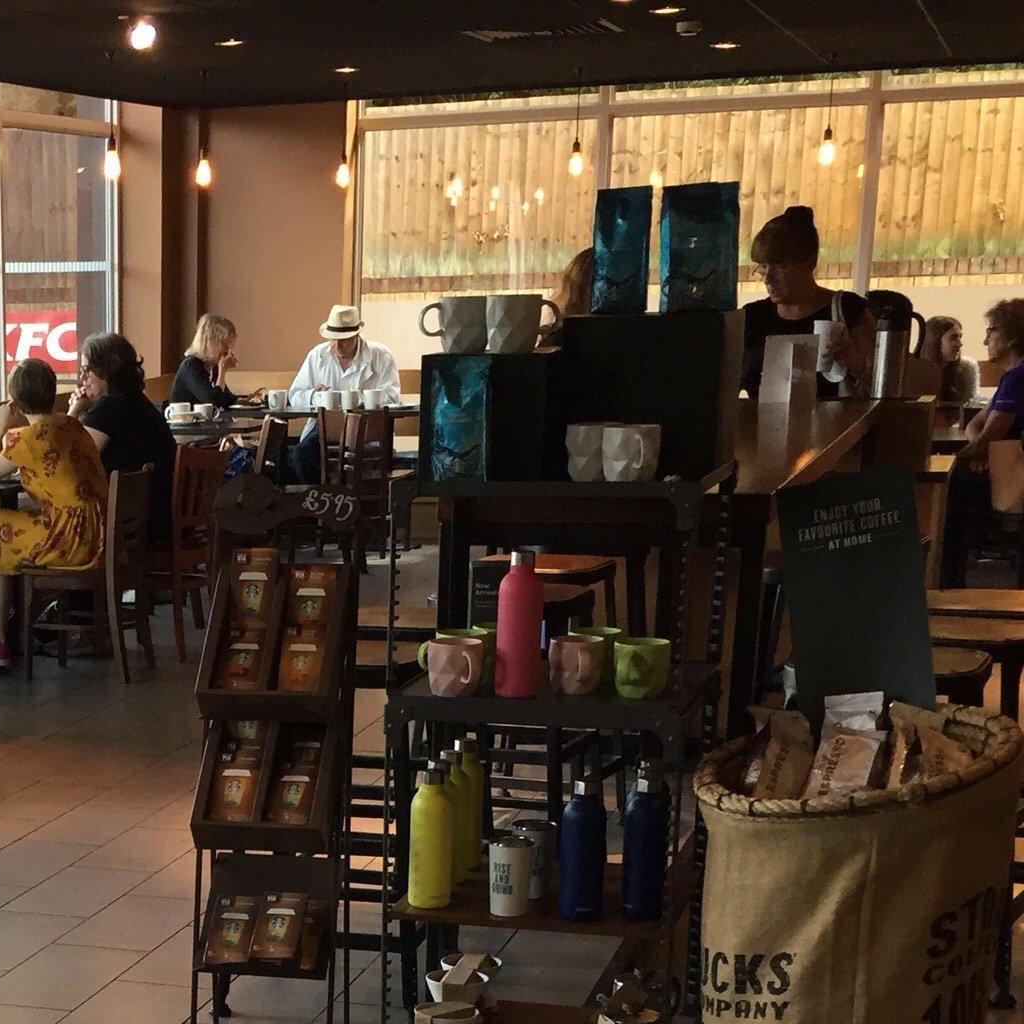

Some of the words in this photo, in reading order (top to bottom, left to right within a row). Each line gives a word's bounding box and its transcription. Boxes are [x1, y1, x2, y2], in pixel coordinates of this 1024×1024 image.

[814, 504, 848, 523] ENJOY
[852, 498, 881, 515] YOUR
[798, 519, 855, 542] FAVOURITE
[860, 510, 900, 530] COFFEE
[828, 539, 840, 550] AT
[843, 532, 873, 548] HOME
[493, 862, 512, 874] RISE
[494, 873, 510, 885] AND
